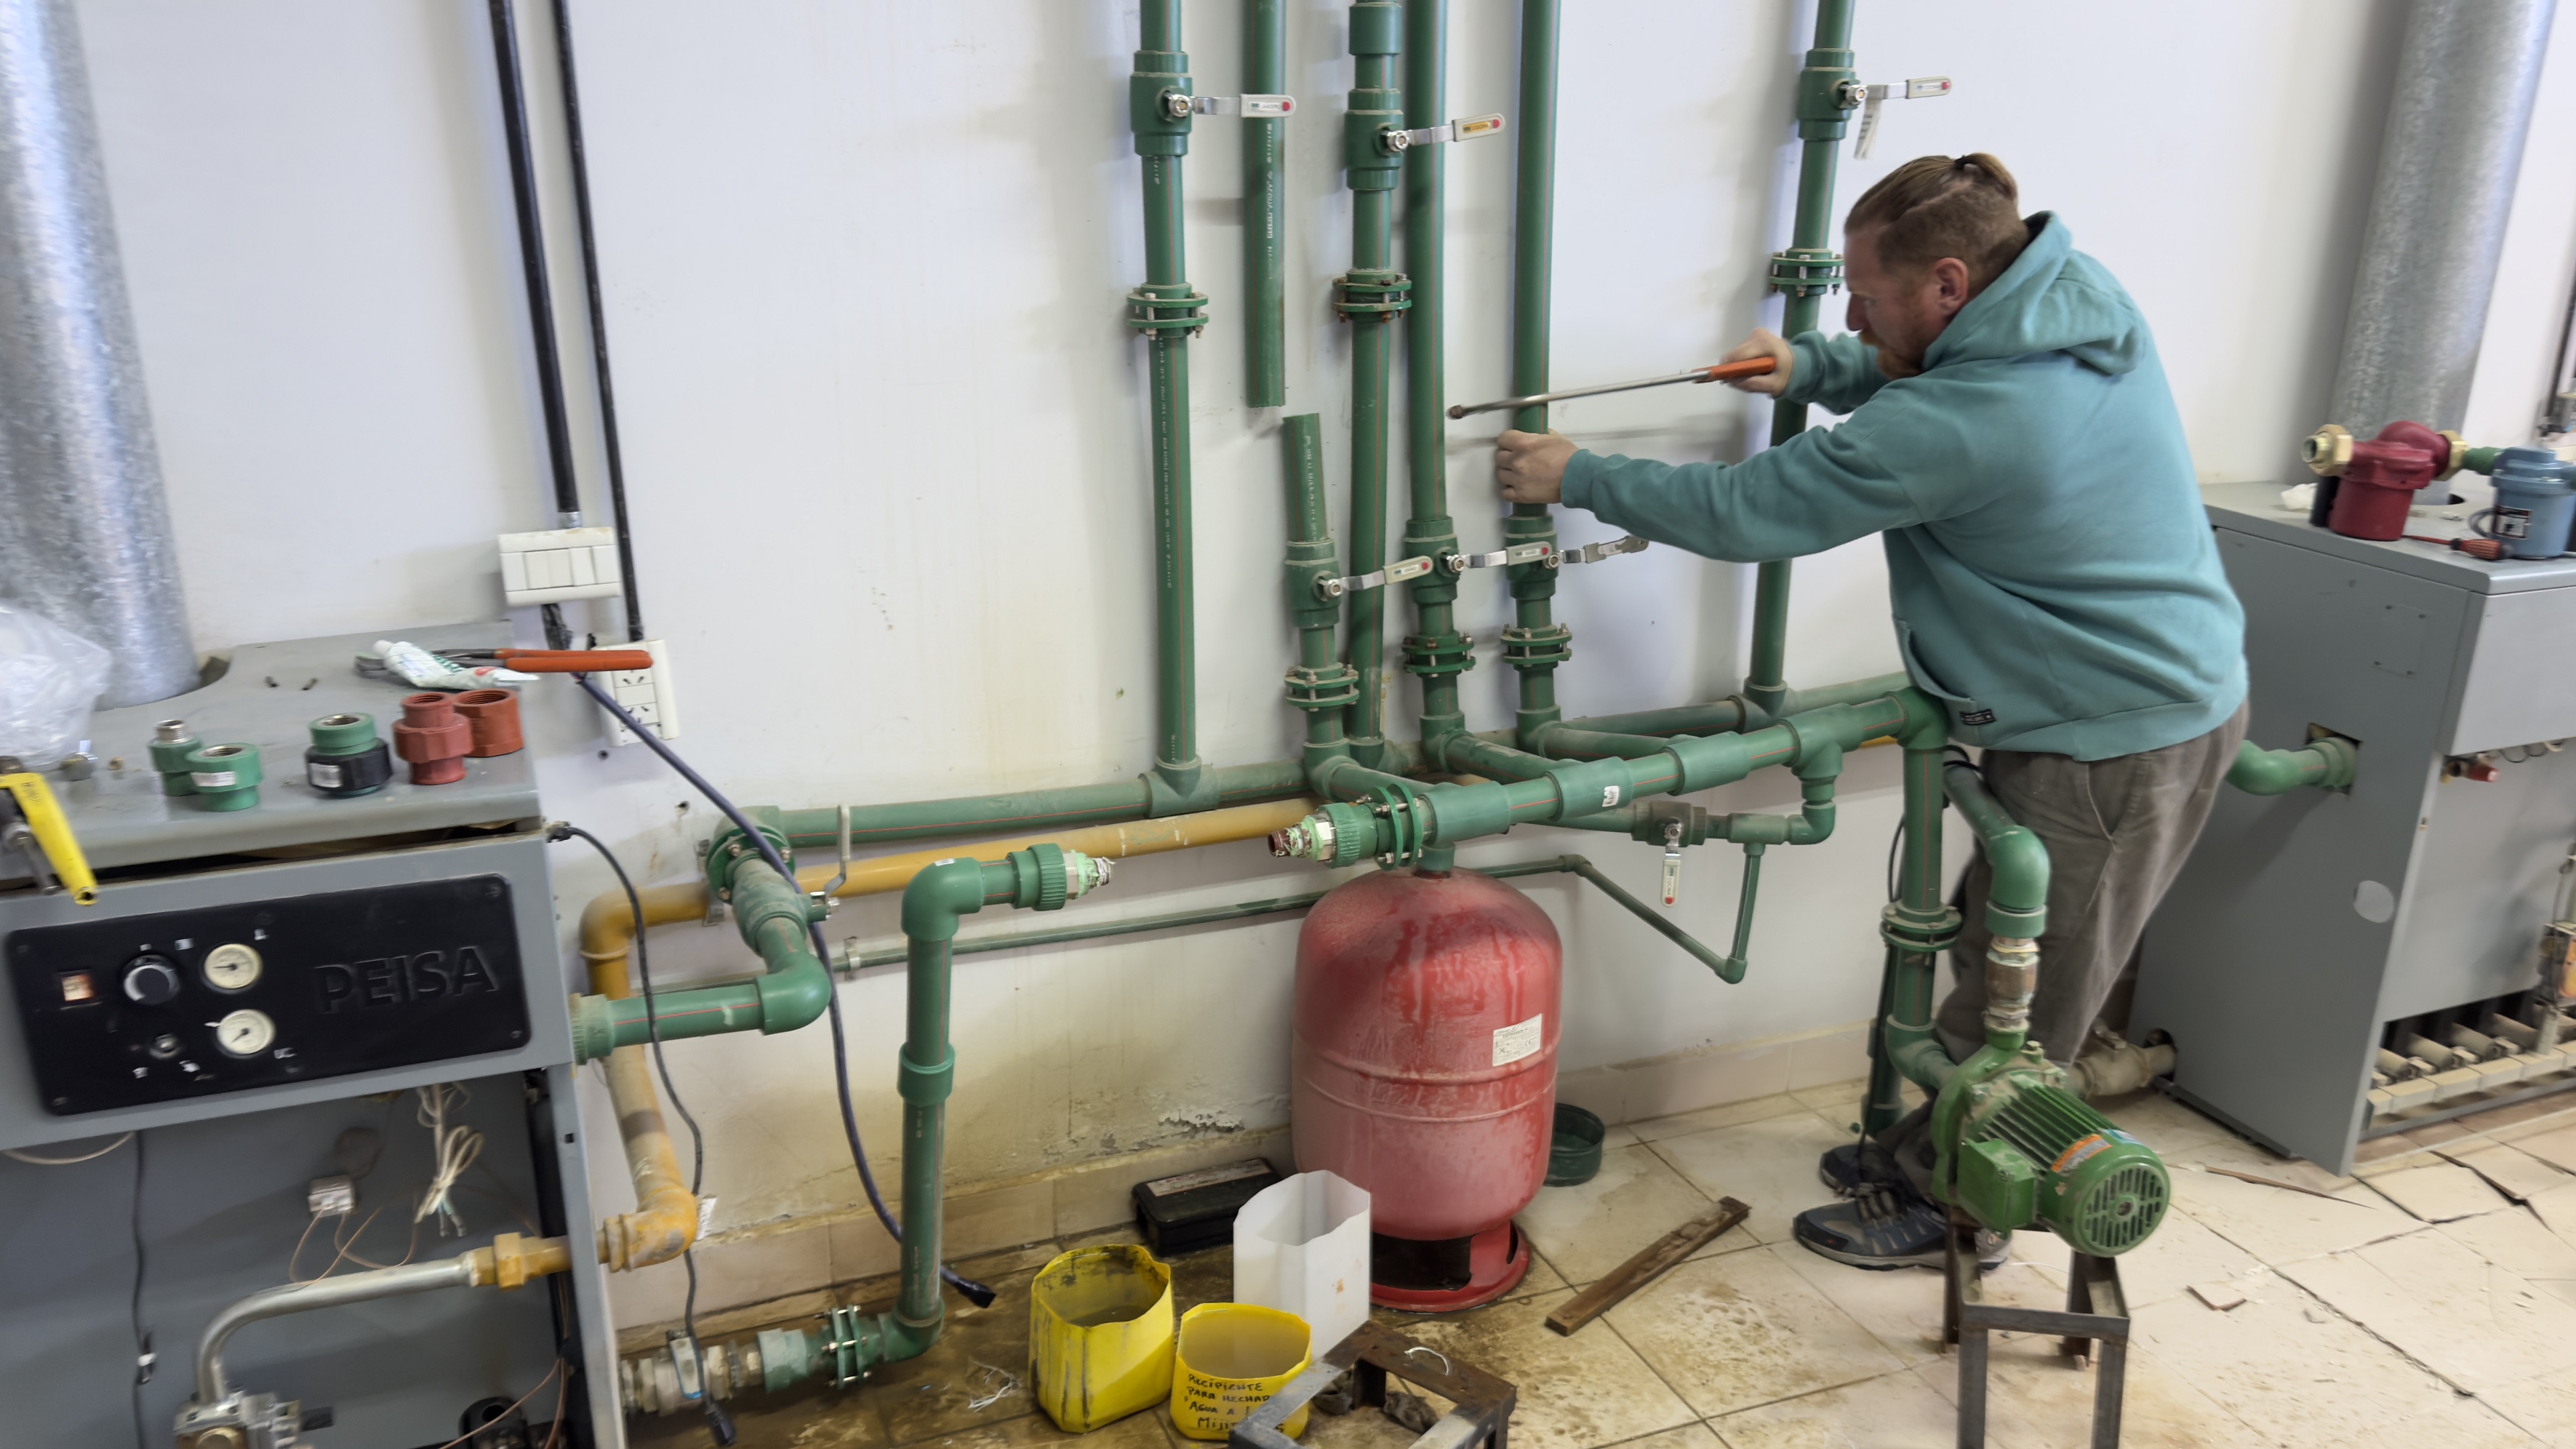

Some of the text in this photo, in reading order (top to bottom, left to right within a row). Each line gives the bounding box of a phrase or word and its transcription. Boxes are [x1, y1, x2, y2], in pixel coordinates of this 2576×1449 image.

[314, 945, 499, 1014] PEISA
[1187, 1386, 1215, 1399] PARA
[1189, 1401, 1218, 1413] AGUA
